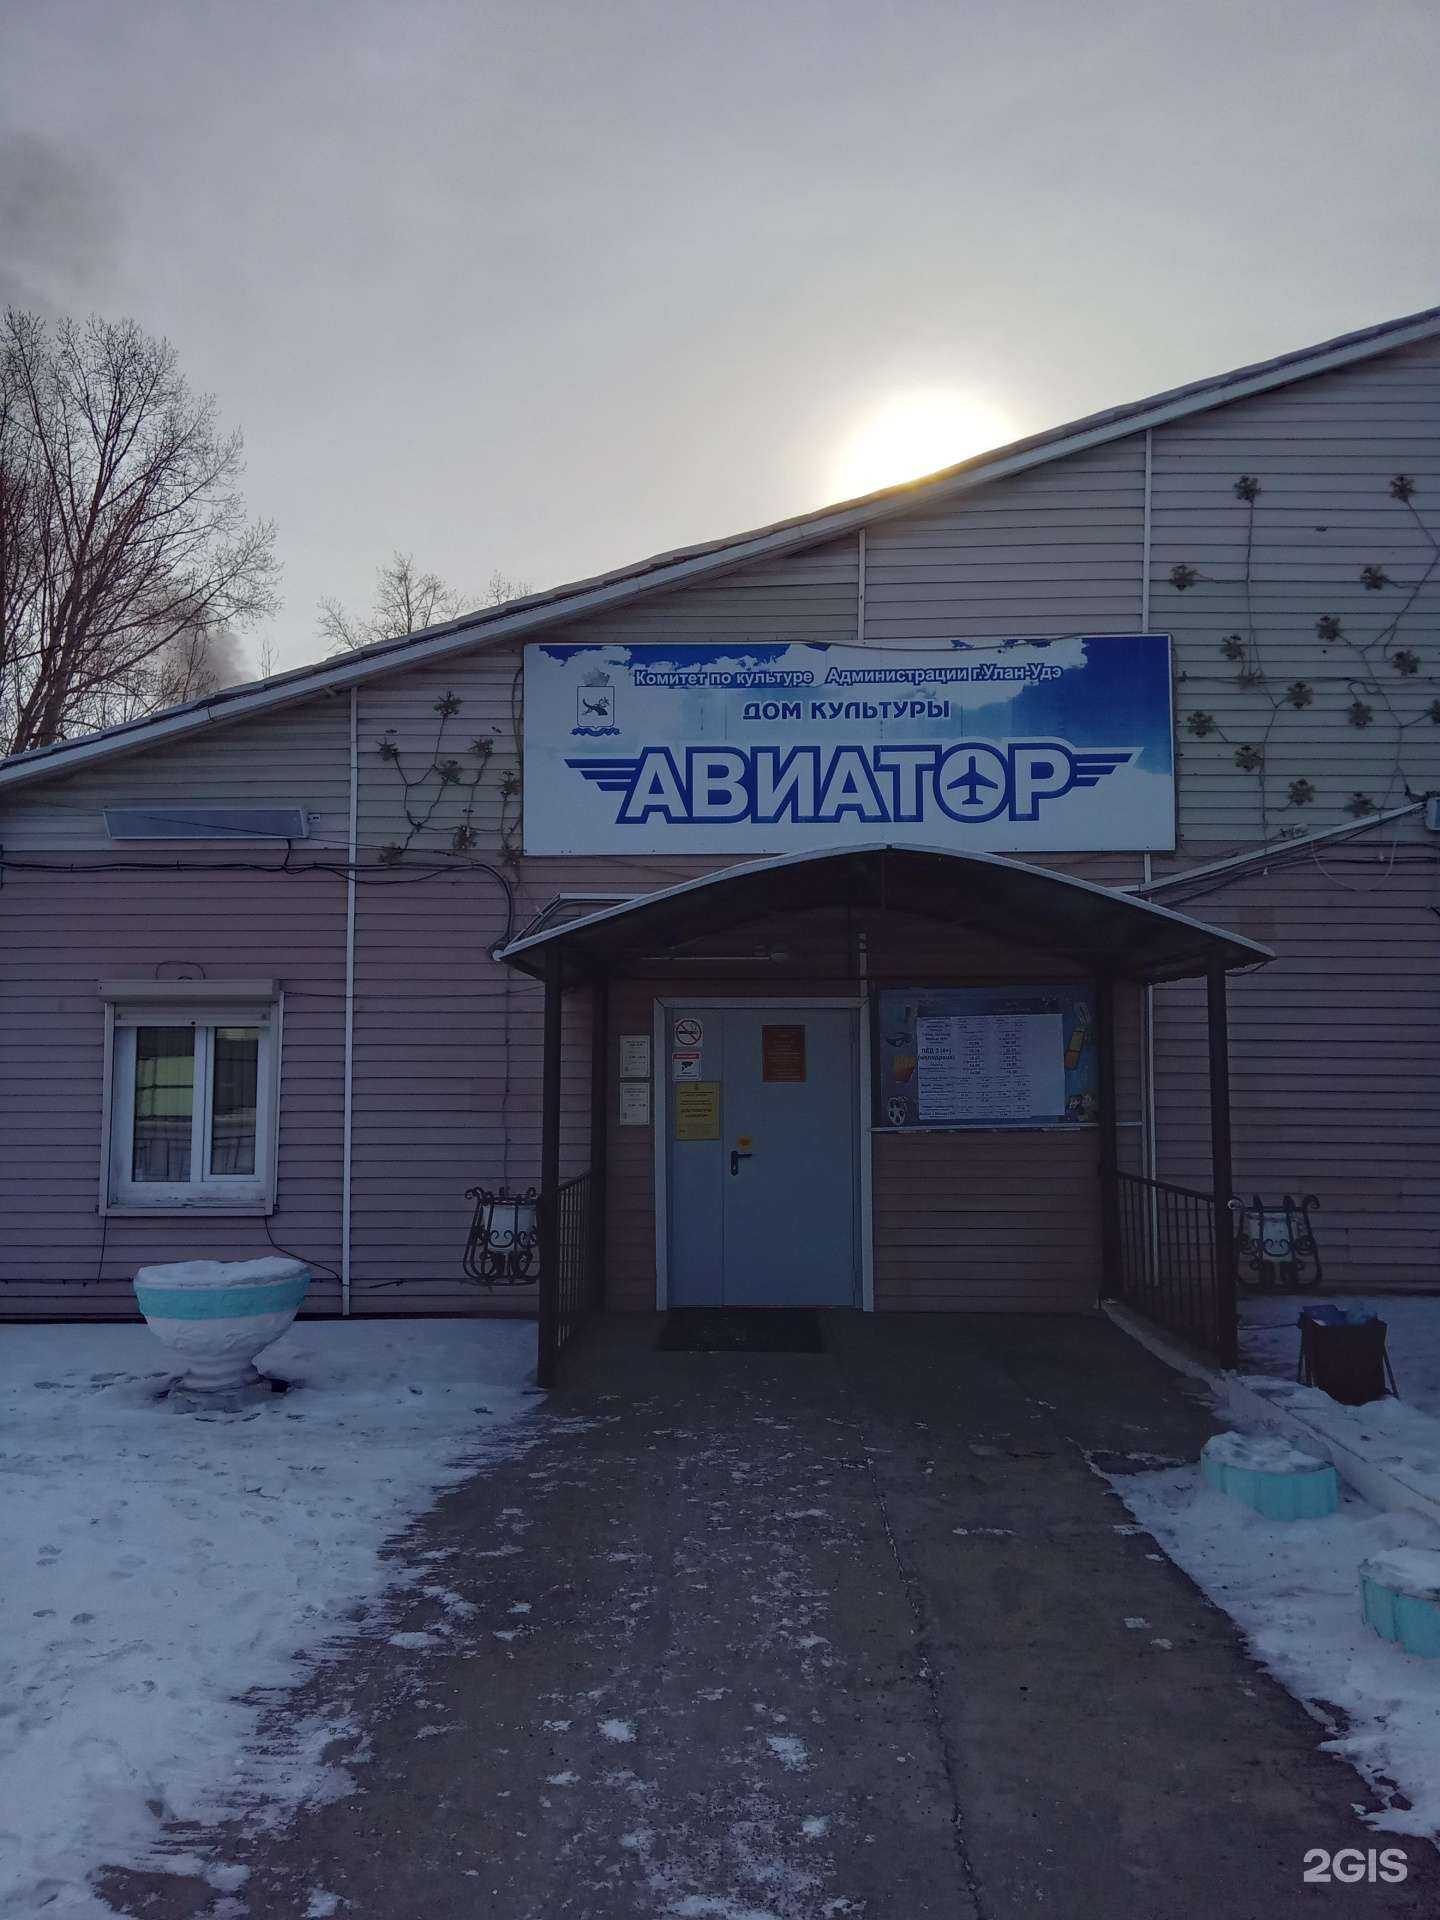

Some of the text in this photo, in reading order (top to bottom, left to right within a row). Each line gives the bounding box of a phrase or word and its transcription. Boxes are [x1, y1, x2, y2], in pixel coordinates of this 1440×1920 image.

[635, 669, 708, 686] Комитет
[710, 672, 734, 686] по
[735, 670, 814, 688] культуре
[825, 667, 968, 686] Администрации
[743, 700, 950, 720] ДОМ КУЛЬТУРЫ
[615, 742, 1073, 824] АВИАТОР
